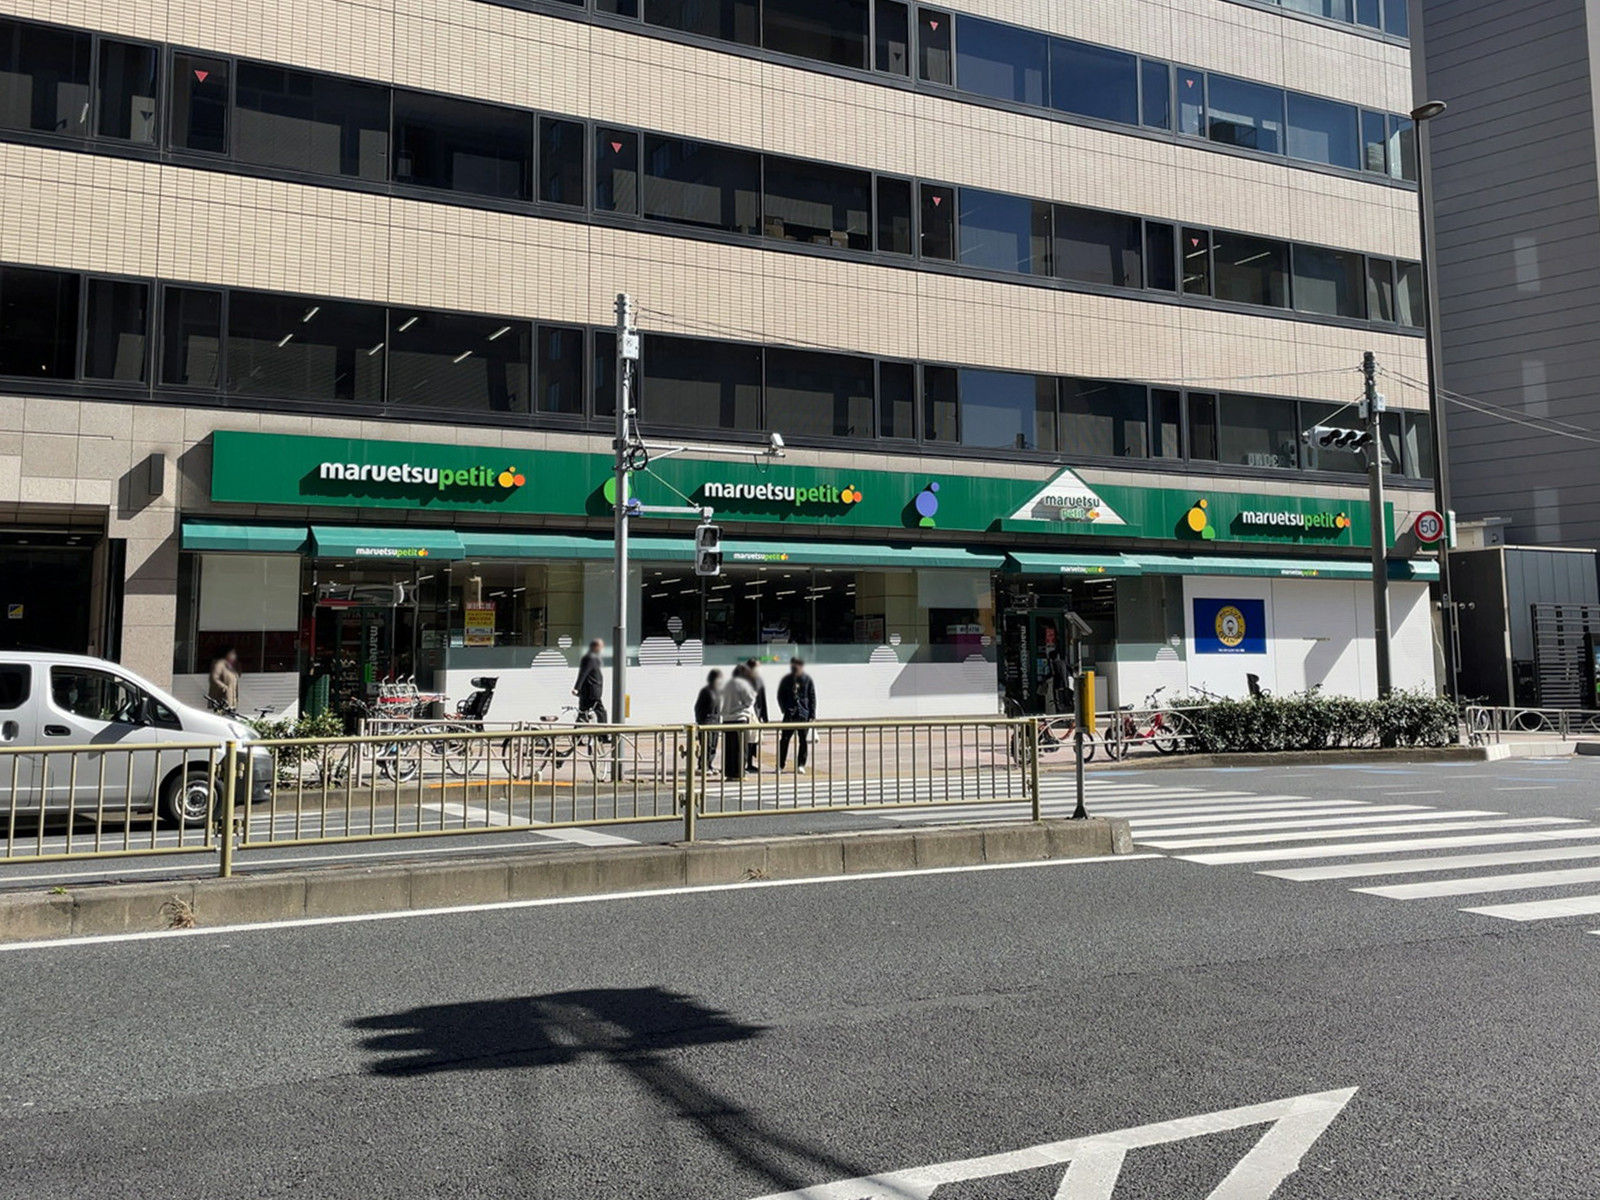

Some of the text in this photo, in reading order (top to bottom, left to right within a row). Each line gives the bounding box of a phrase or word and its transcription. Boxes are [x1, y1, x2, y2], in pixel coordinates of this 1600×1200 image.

[320, 461, 495, 491] maruetsupetit
[704, 482, 840, 507] maruetsupetit
[1045, 493, 1100, 508] maruetsu
[1059, 506, 1086, 520] petit
[1242, 509, 1336, 531] maruetsupetit
[1420, 519, 1437, 534] 50
[355, 546, 418, 557] maruetsupetit
